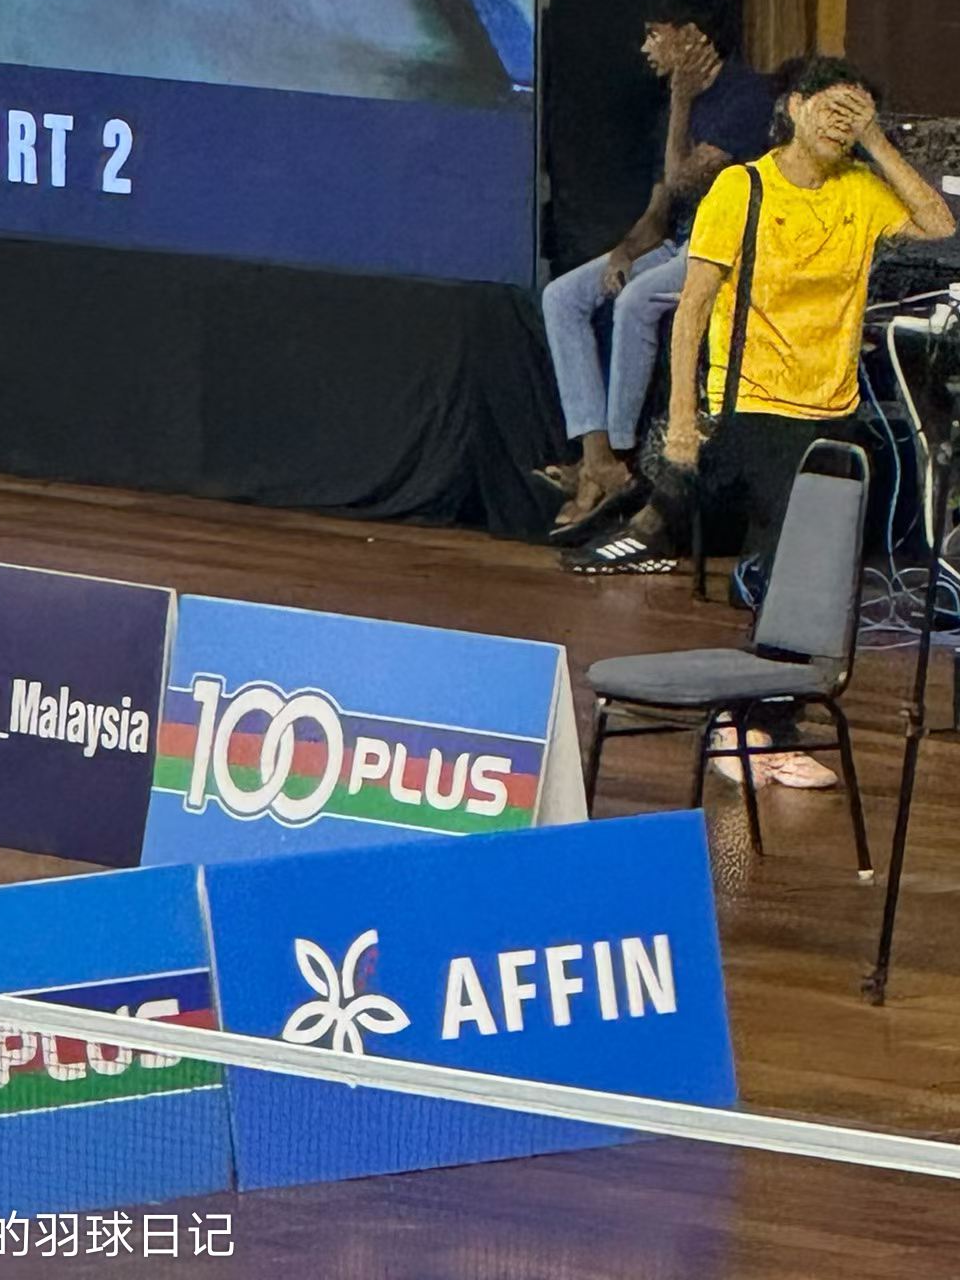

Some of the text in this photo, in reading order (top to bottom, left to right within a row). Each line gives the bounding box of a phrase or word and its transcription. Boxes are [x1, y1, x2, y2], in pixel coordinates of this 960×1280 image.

[102, 118, 133, 194] 2
[190, 680, 512, 819] 100 PLUS
[441, 934, 677, 1040] AFFIN
